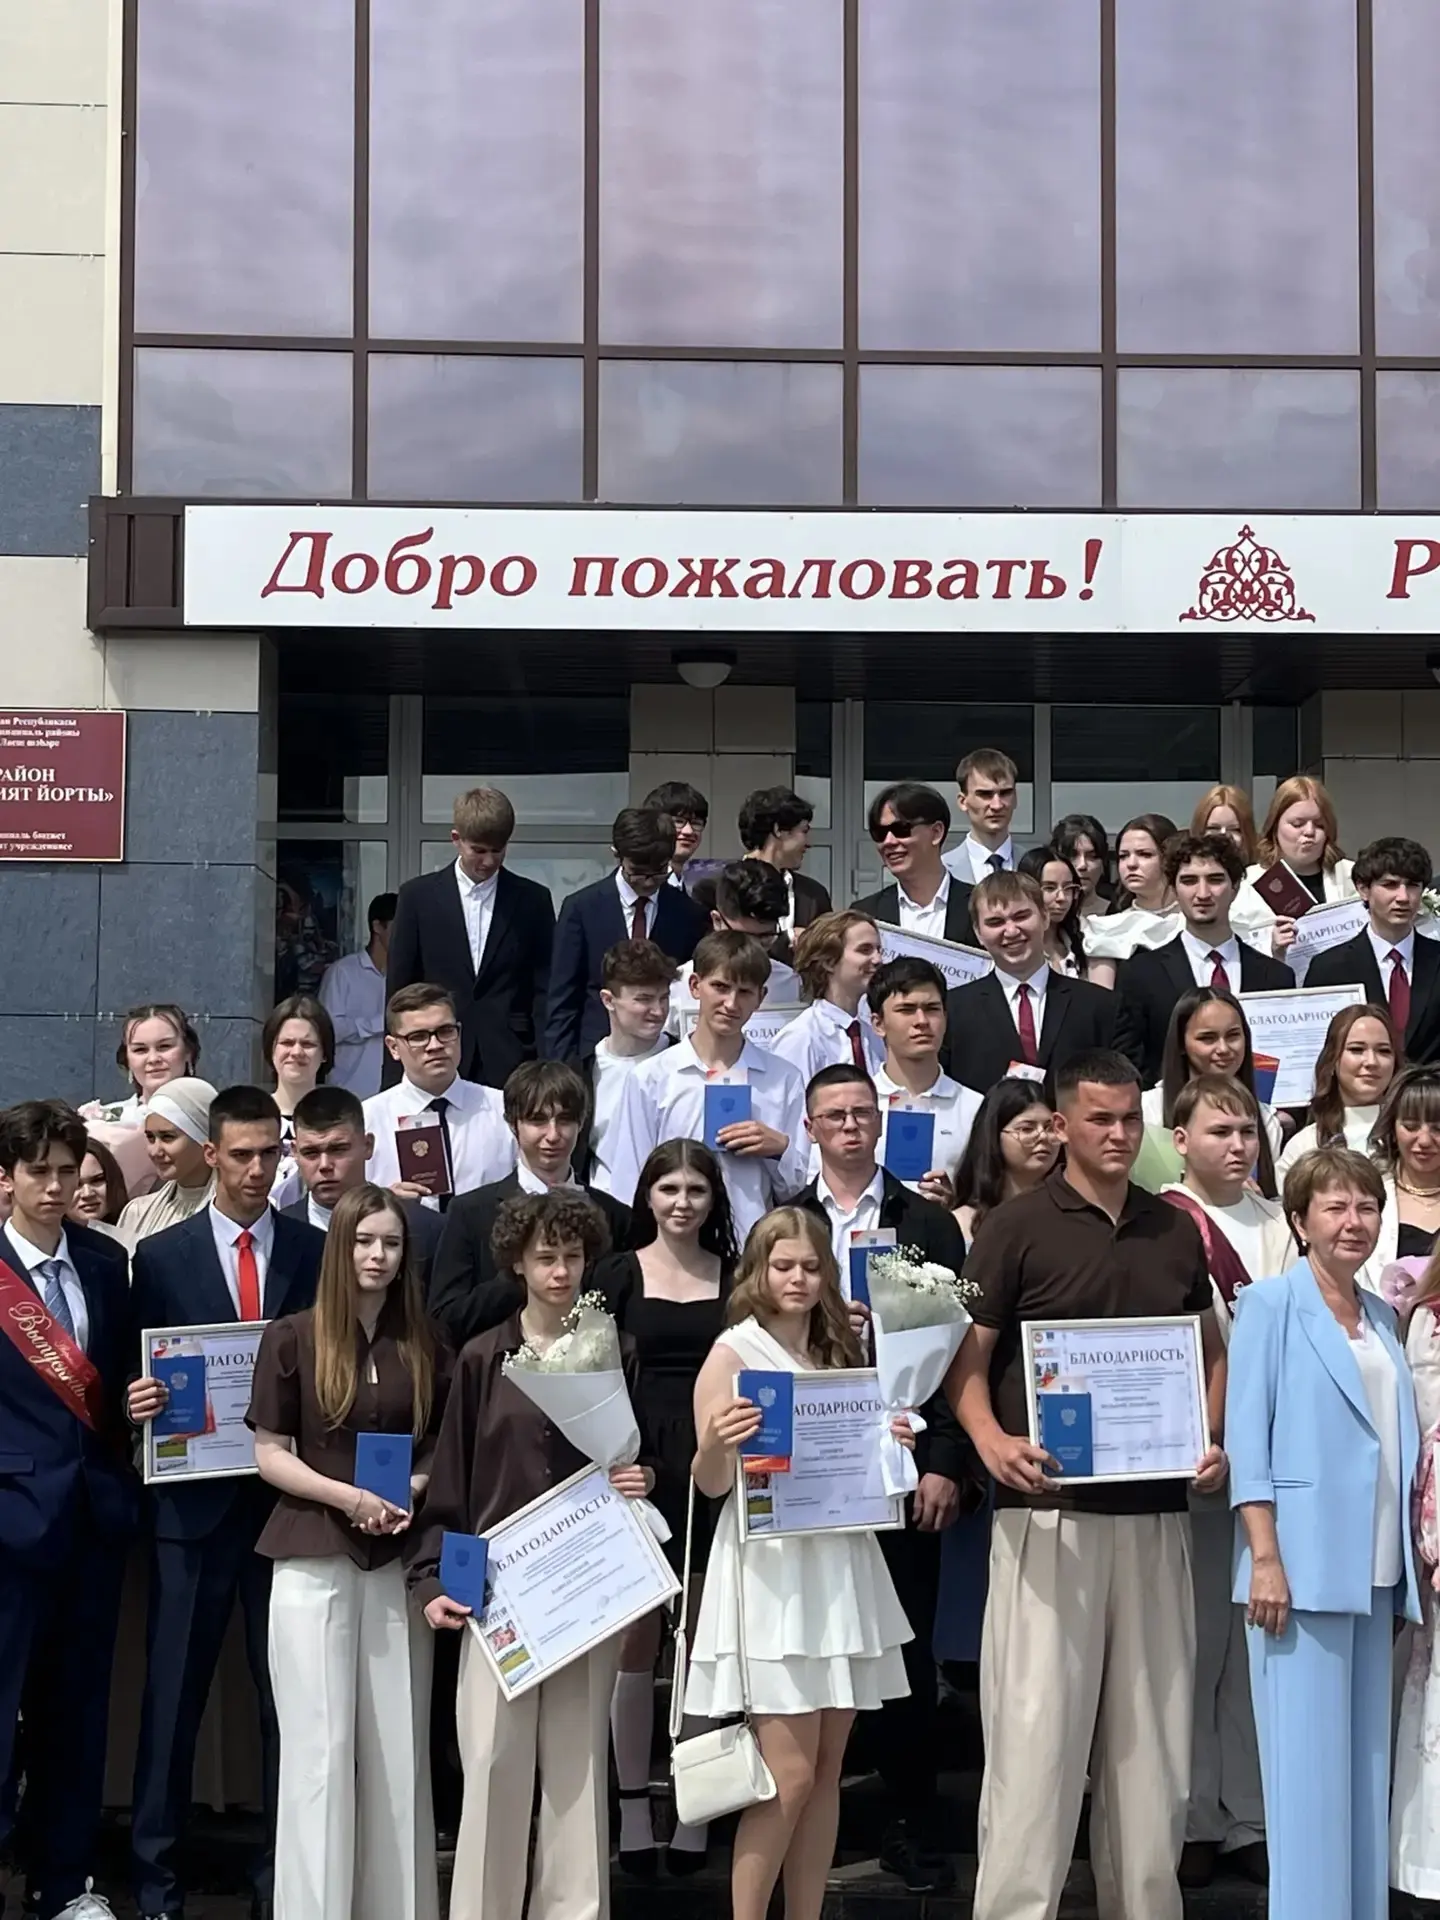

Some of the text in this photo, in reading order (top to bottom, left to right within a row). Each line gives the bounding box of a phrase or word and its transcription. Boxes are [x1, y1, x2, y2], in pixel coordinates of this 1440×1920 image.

[261, 527, 1103, 610] Добро пожаловать!
[1386, 539, 1440, 599] Р
[0, 764, 55, 782] РАЙОН
[37, 784, 114, 802] ЙОРТЫ»
[1069, 1348, 1185, 1365] БЛАГОДАРНОСТЬ
[496, 1493, 612, 1572] БЛАГОДАРНОСТЬ
